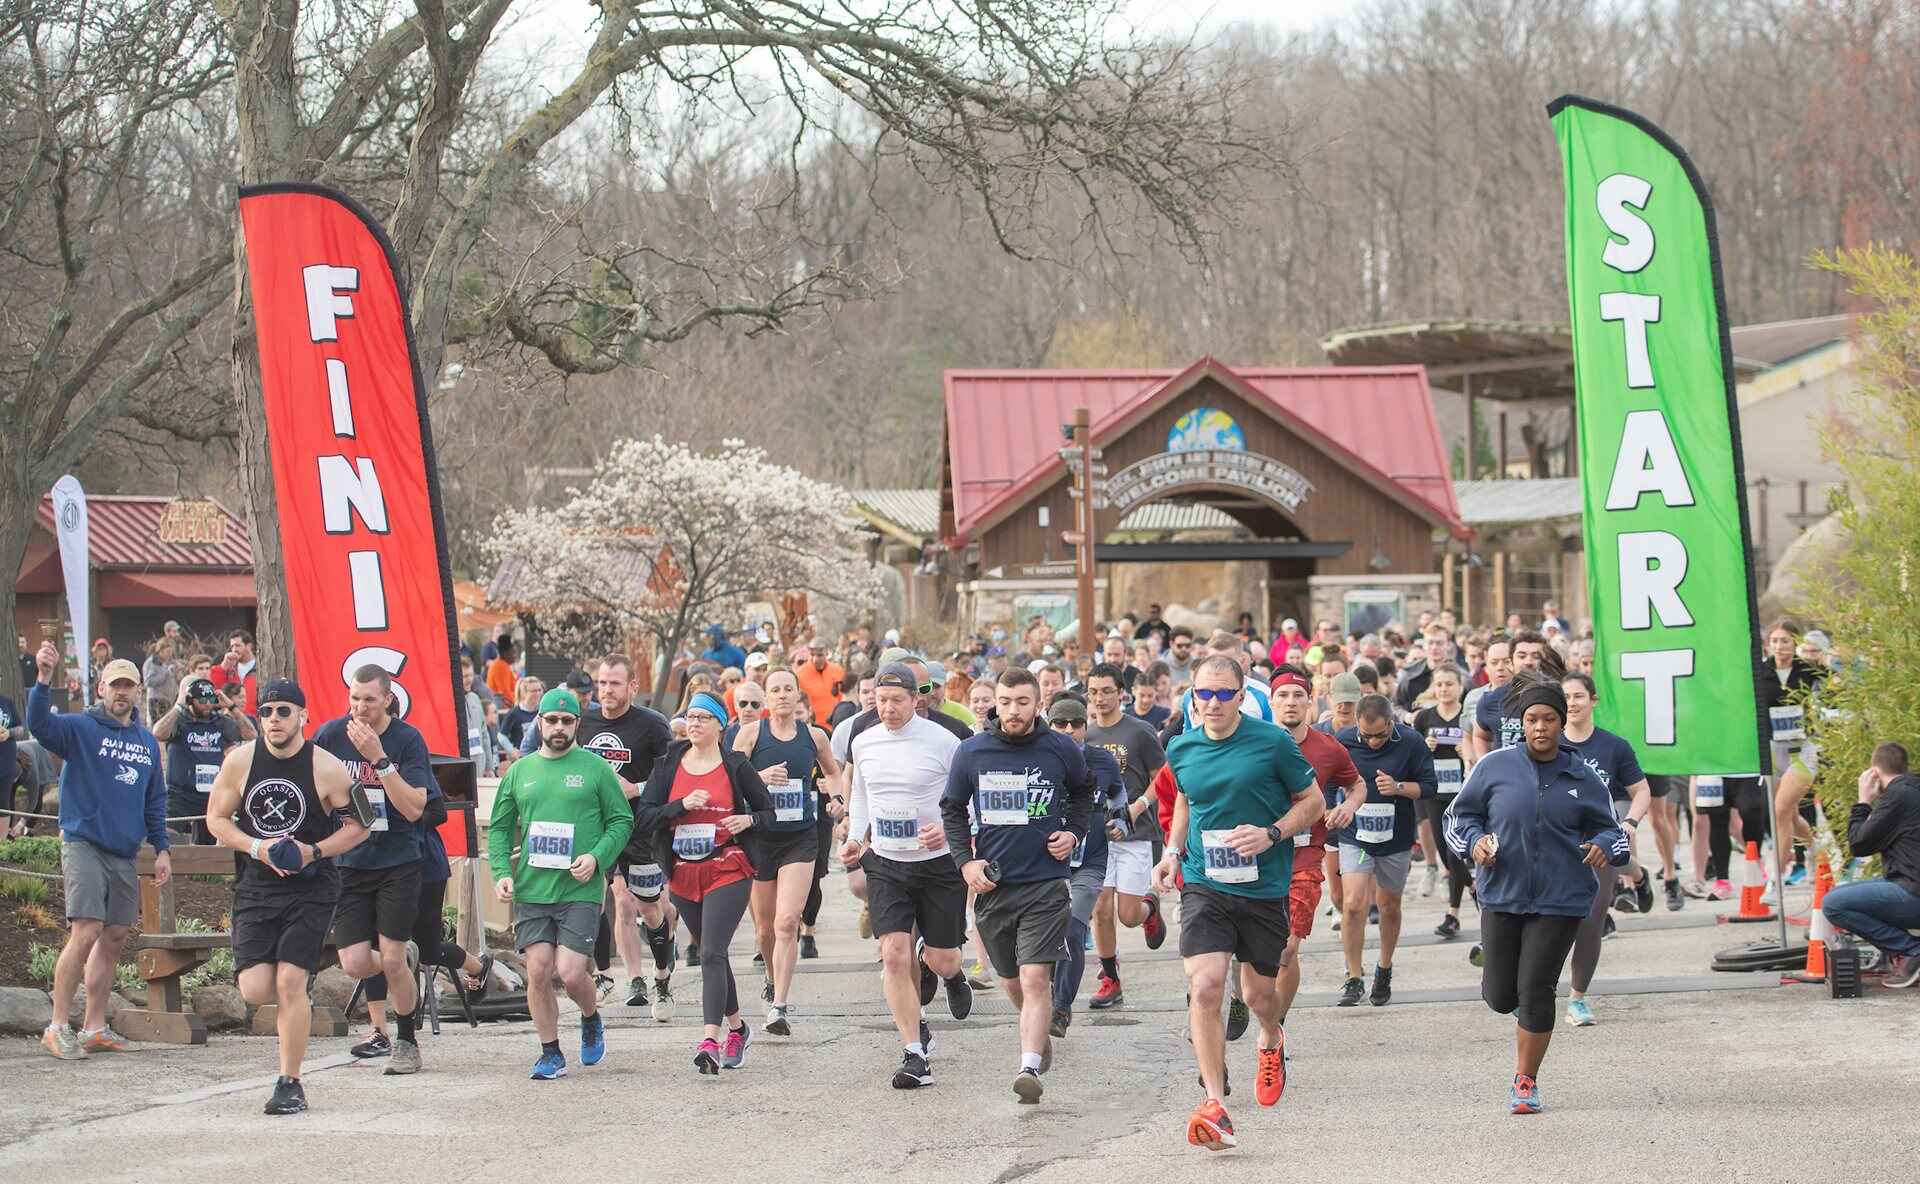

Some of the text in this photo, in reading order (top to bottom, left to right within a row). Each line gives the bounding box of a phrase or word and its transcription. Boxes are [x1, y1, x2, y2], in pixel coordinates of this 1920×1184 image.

[1595, 172, 1695, 747] START
[1114, 467, 1301, 508] WELCOME PAVILION
[101, 737, 124, 749] RUN
[98, 747, 108, 757] A
[259, 784, 296, 799] OCASIO
[1027, 788, 1055, 804] TH
[980, 790, 1025, 810] 1650
[1027, 802, 1048, 816] 5K
[877, 819, 915, 838] 1350
[1359, 816, 1392, 832] 1587
[531, 836, 570, 855] 1458
